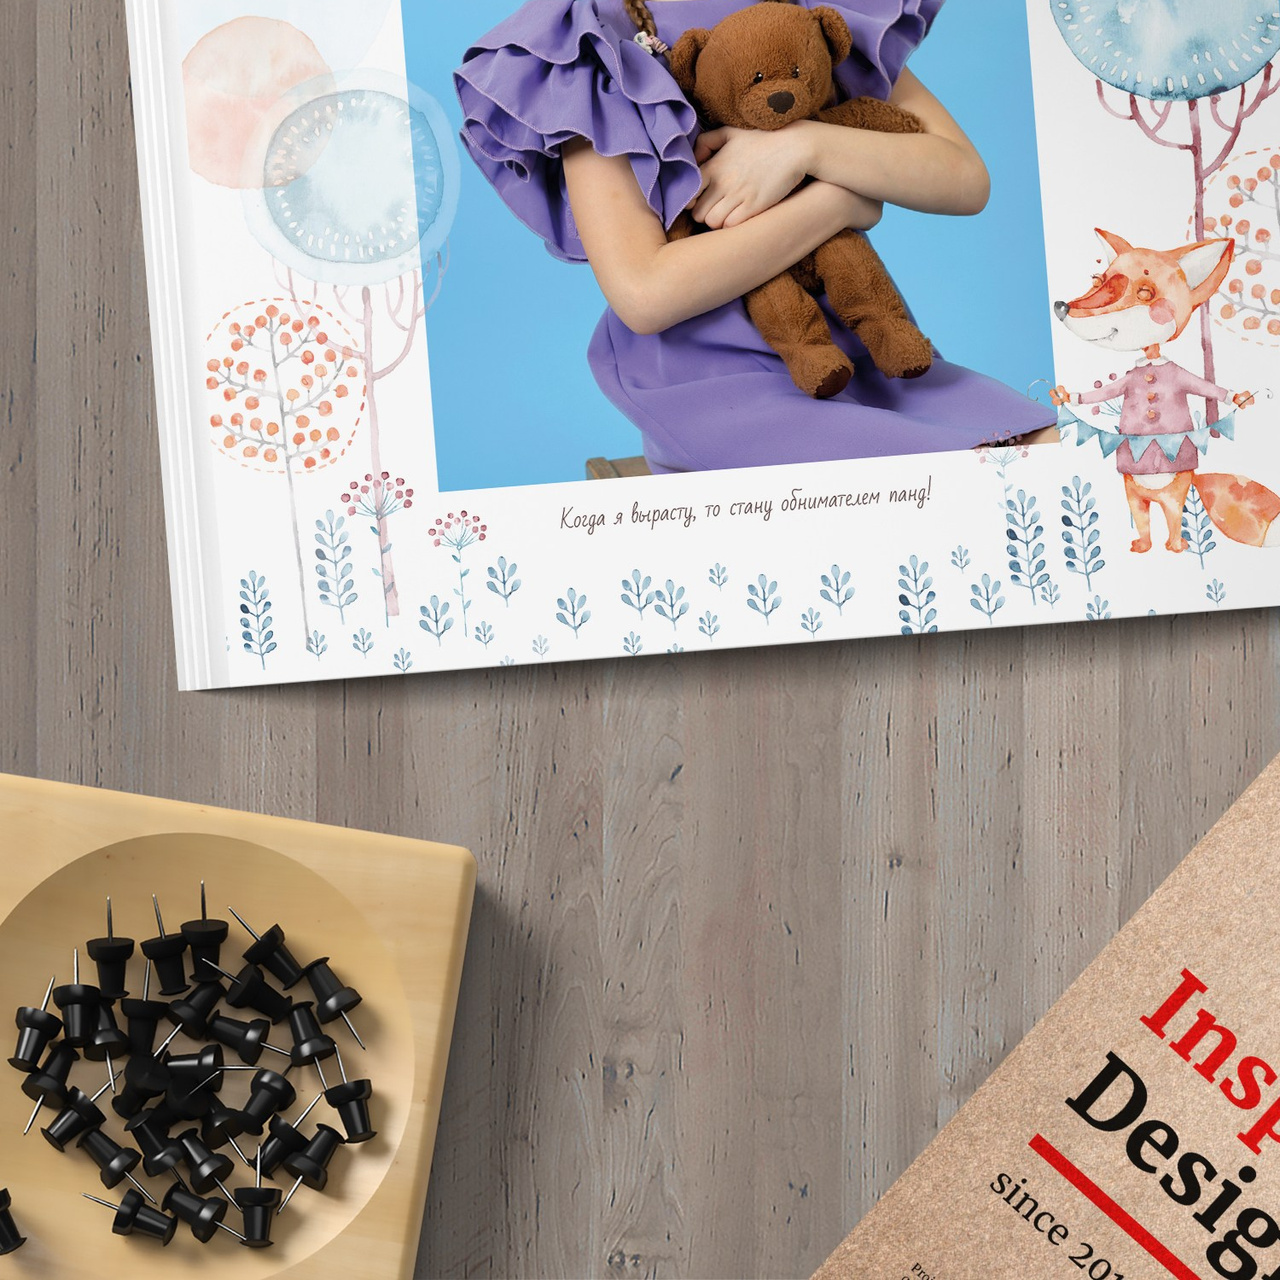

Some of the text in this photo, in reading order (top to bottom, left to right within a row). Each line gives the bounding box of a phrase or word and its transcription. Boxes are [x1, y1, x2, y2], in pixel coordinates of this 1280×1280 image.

[560, 475, 932, 536] Когда я вырасту, то стану обнимателем панд!
[989, 1172, 1125, 1280] since 20
